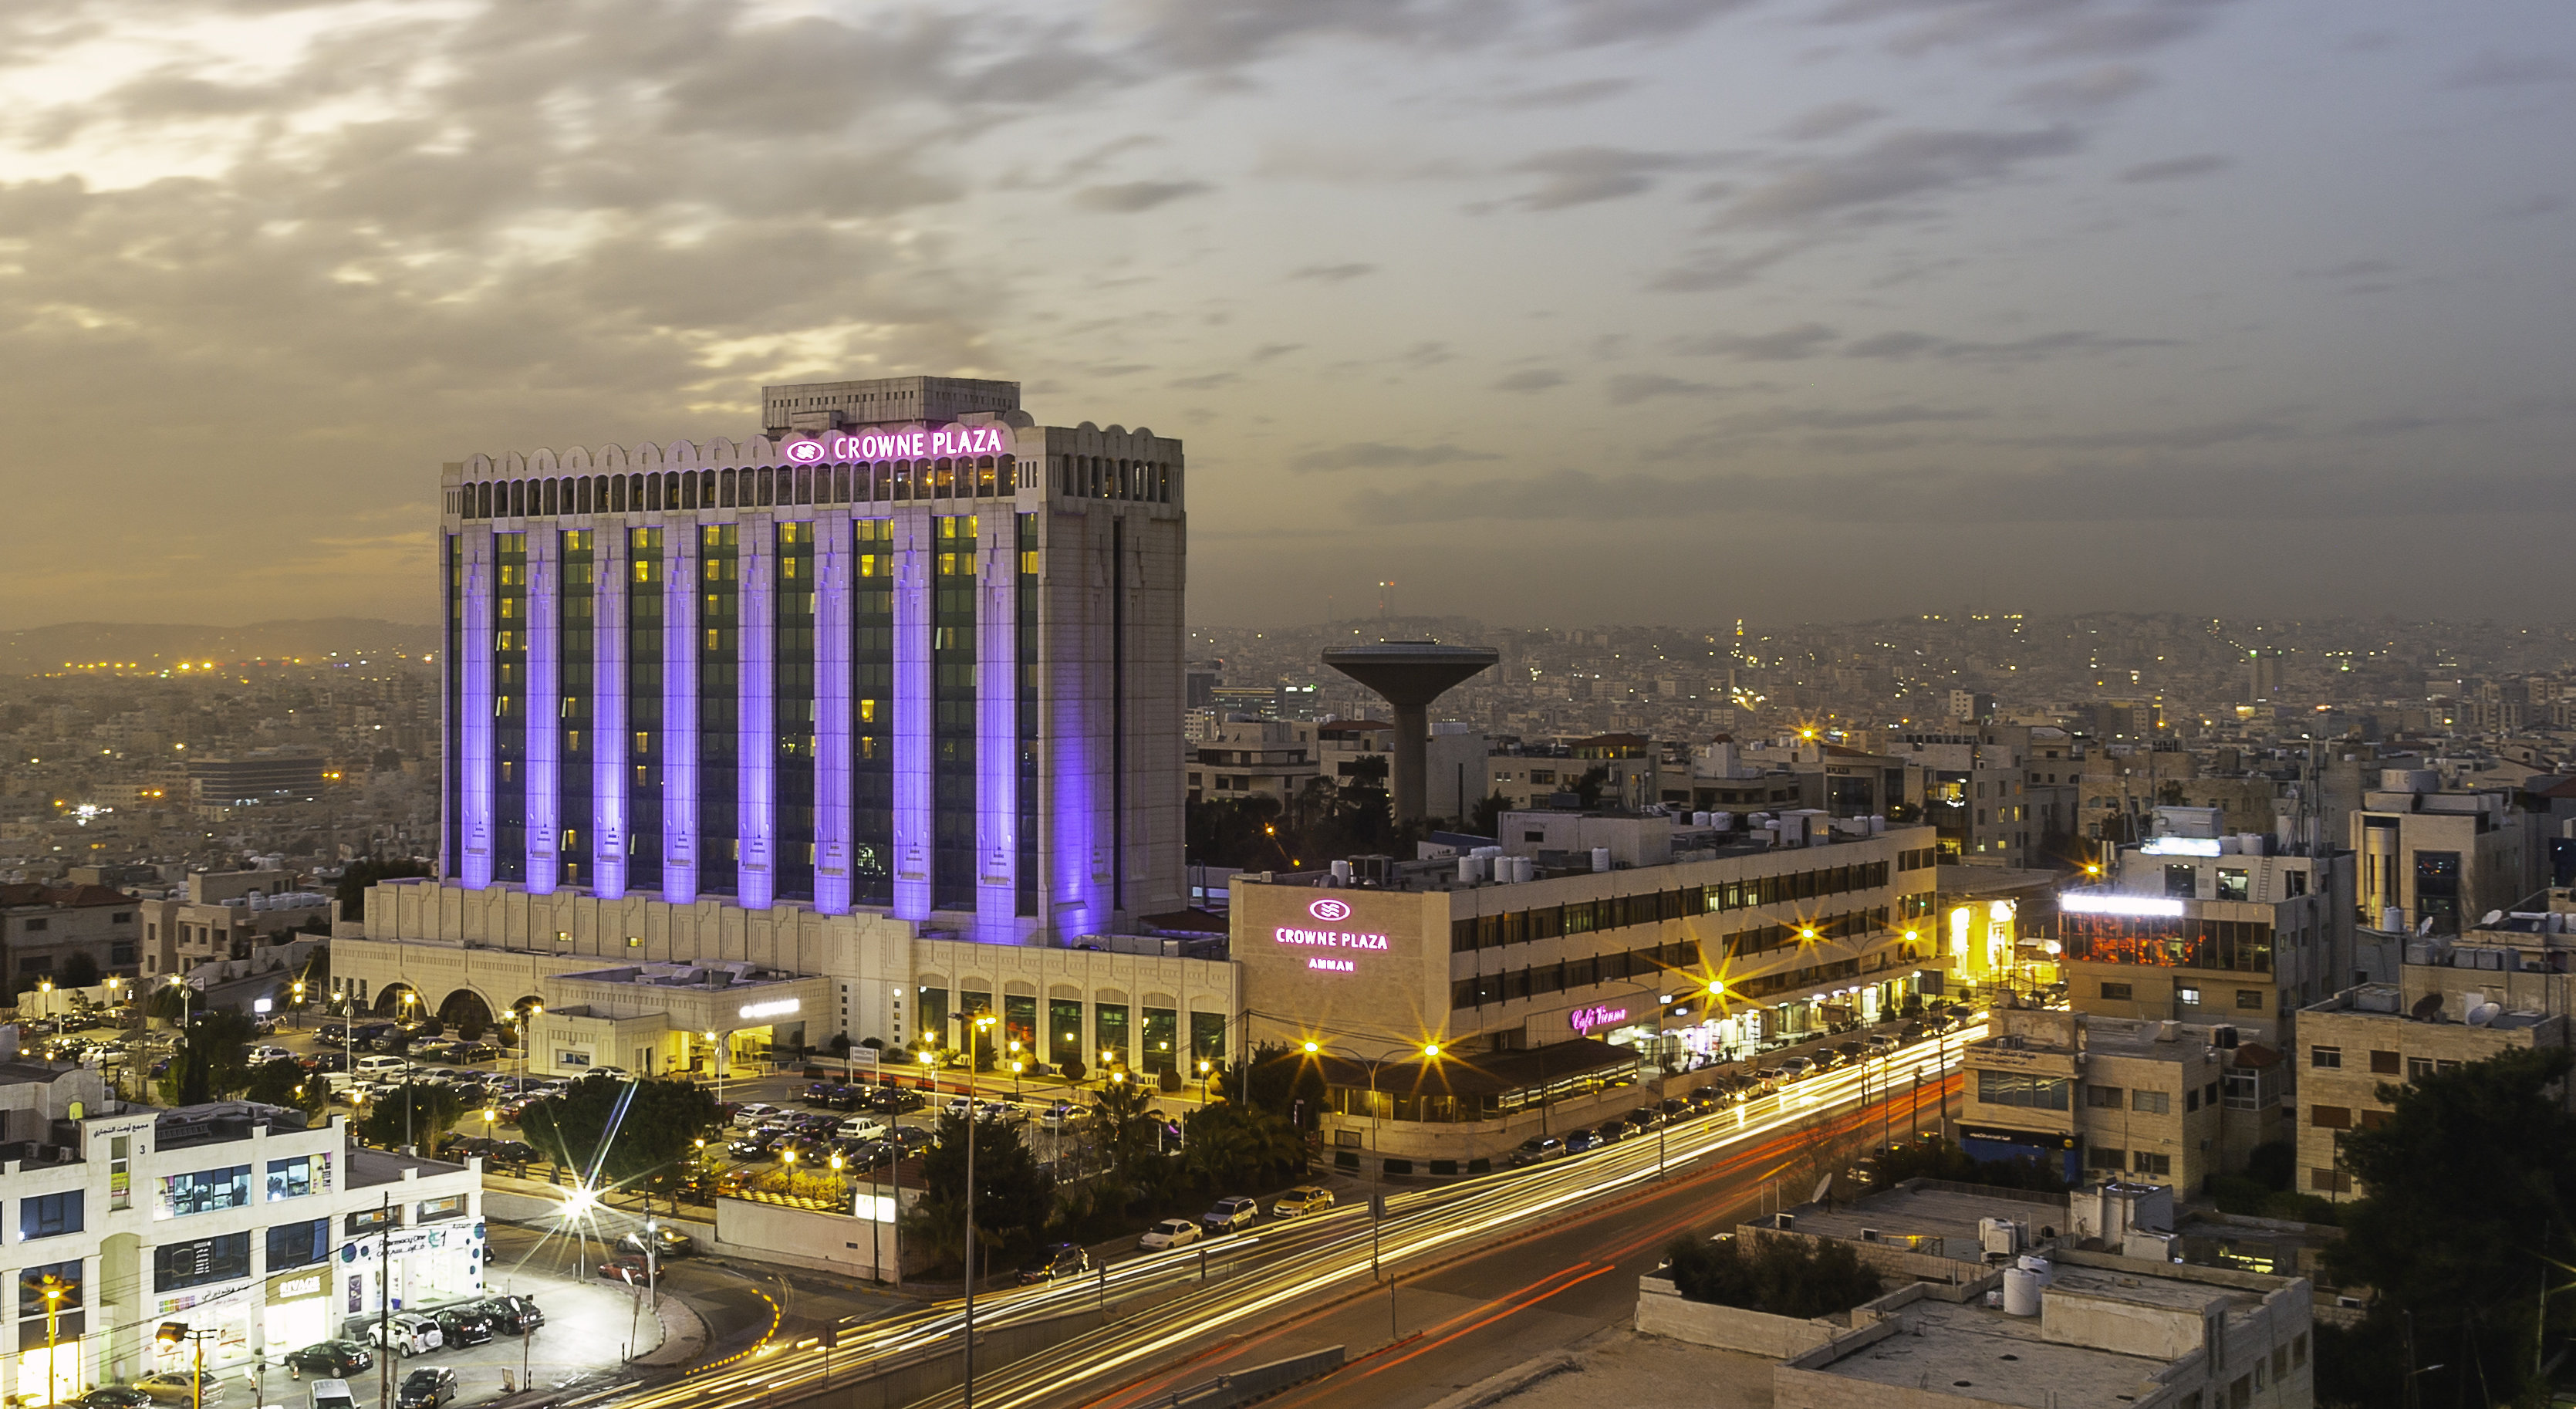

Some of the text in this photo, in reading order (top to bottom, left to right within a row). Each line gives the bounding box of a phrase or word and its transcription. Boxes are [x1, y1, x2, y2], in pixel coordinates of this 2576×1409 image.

[834, 429, 1002, 460] CROWNE PLAZA
[1275, 928, 1388, 950] CROWNE PLAZA
[1309, 958, 1354, 972] AMMAN
[1595, 1005, 1626, 1025] Vienna
[140, 1144, 146, 1154] 3
[378, 1237, 413, 1248] Parmacy
[279, 1276, 321, 1293] RIVAGE
